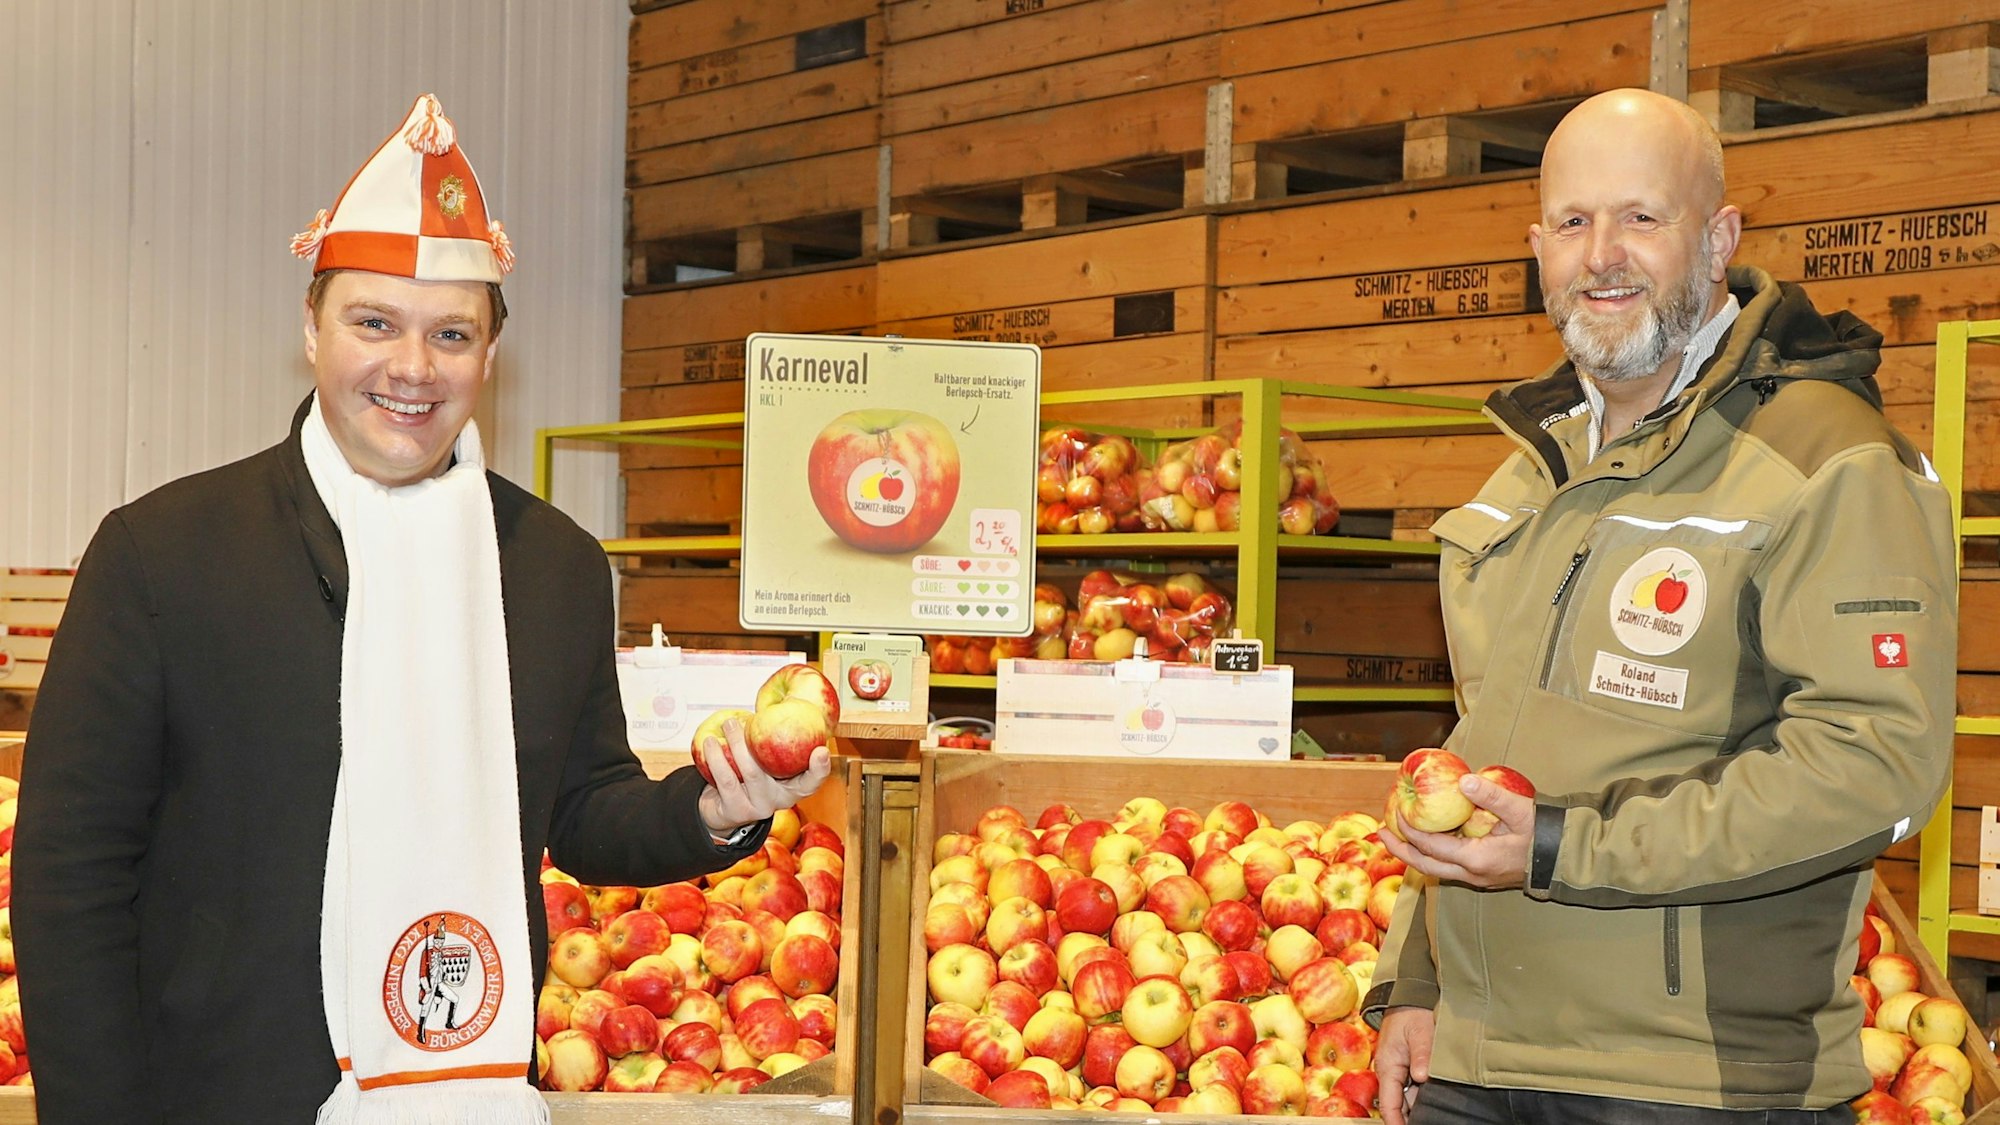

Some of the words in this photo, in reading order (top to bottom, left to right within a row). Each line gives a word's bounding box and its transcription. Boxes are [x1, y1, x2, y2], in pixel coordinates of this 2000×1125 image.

[1805, 221, 1883, 250] SCHMITZ
[1901, 211, 1987, 242] HUEBSCH
[1804, 251, 1874, 279] MERTEN
[1885, 246, 1931, 273] 2009
[1355, 274, 1411, 297] SCHMITZ
[1427, 267, 1489, 292] HUEBSCH
[1383, 297, 1435, 320] MERTEN
[1458, 293, 1488, 314] 6.98
[953, 314, 995, 333] SCHMITZ
[1004, 308, 1050, 329] HUEBSCH
[760, 347, 868, 385] Karneval
[934, 373, 971, 385] Haltbarer
[972, 375, 987, 385] und
[988, 376, 1026, 389] knackiger
[946, 386, 1013, 399] Berlepsch-Ersatz.
[760, 394, 775, 406] HKL
[854, 501, 905, 515] SCHMITZ-HÜBSCH
[755, 589, 773, 601] Mein
[774, 590, 799, 602] Aroma
[800, 591, 833, 603] erinnert
[834, 592, 851, 603] dich
[754, 605, 764, 614] an
[766, 604, 787, 615] einen
[788, 604, 828, 617] Berlepsch.
[1618, 609, 1684, 638] SCHMITZ-HÜBSCH
[834, 641, 866, 652] Karneval
[1347, 659, 1403, 681] SCHMITZ
[1621, 663, 1656, 683] Roland
[1596, 675, 1678, 704] Schmitz-Hübsch
[395, 927, 422, 960] KKG
[386, 963, 412, 1034] NIPPESER
[429, 971, 500, 1048] BÜRGERWEHR
